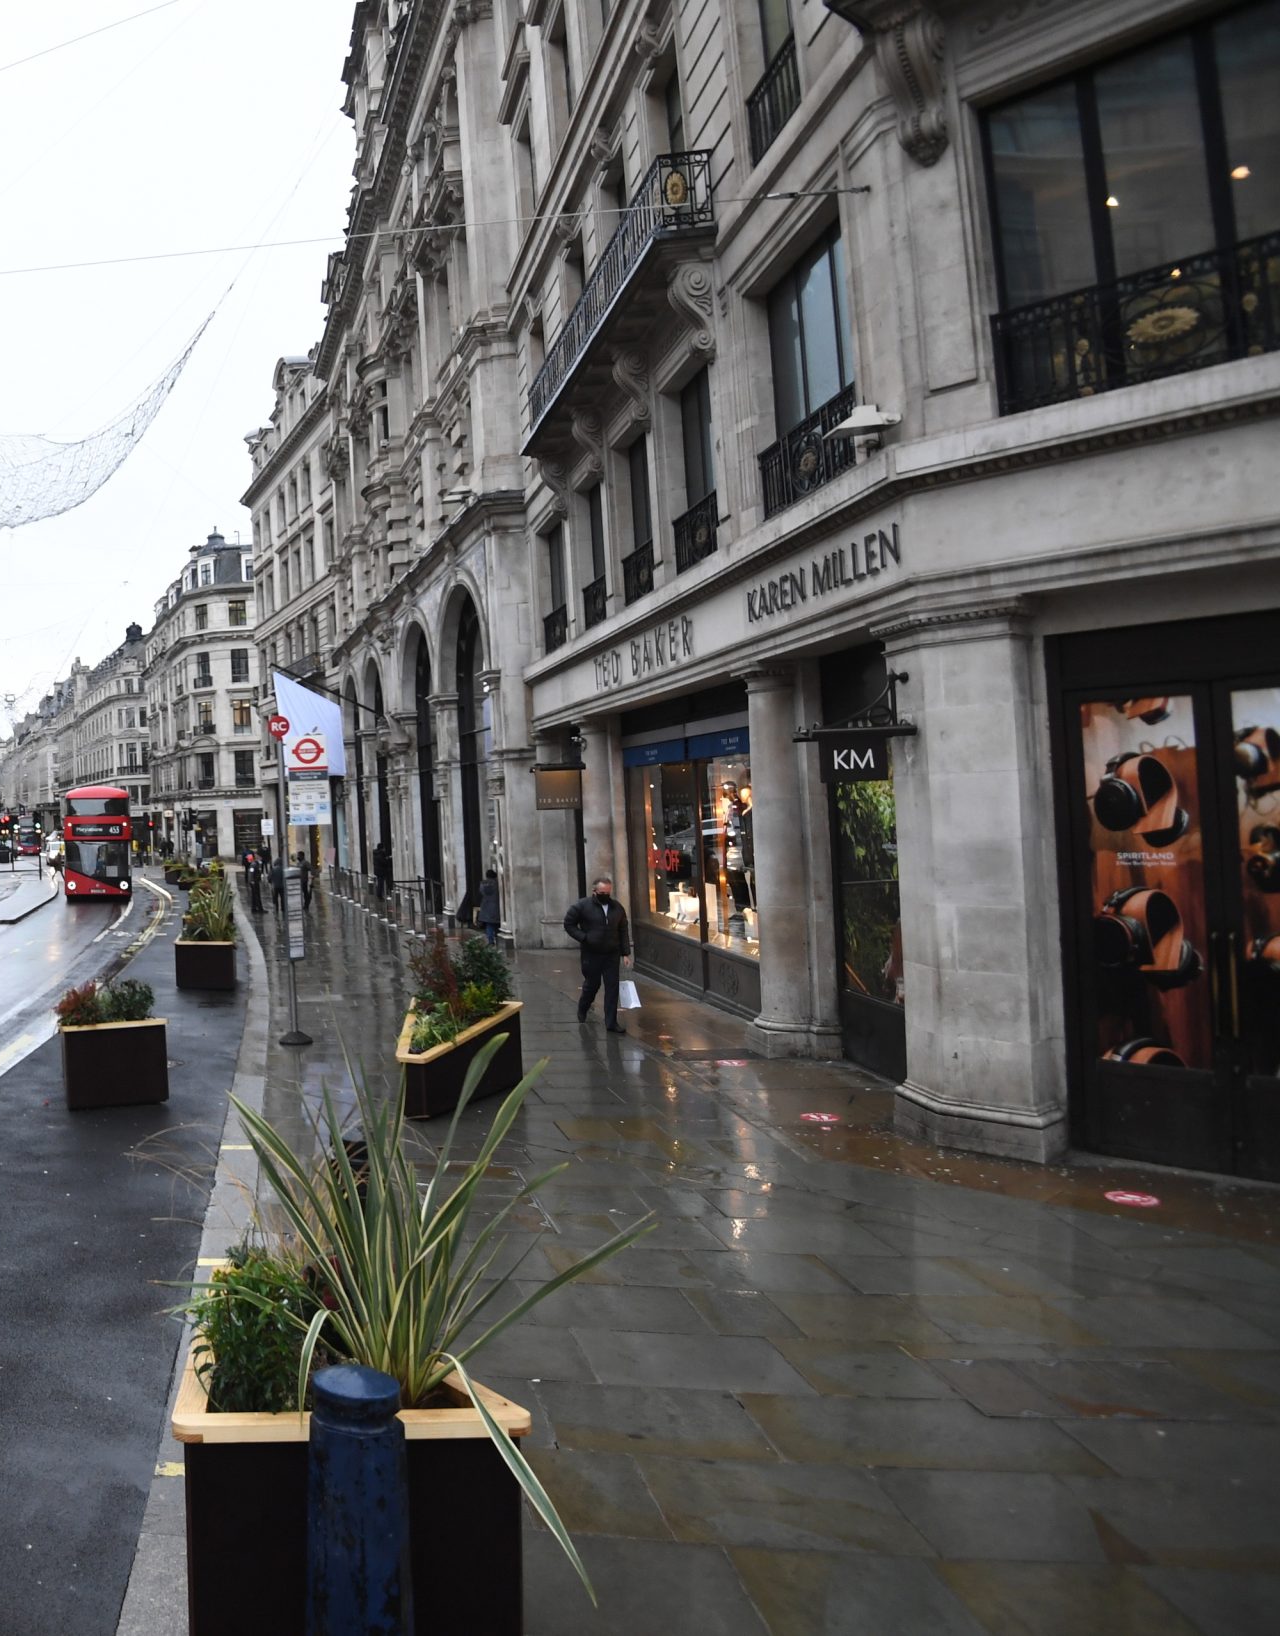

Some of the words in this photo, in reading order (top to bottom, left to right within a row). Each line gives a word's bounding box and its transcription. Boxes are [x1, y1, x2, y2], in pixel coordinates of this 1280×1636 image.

[747, 566, 807, 623] KAREN
[812, 522, 900, 597] MILLEN
[593, 649, 621, 691] TED
[630, 615, 693, 676] BAKER
[271, 721, 287, 731] RC
[833, 748, 875, 770] KM
[1116, 852, 1175, 860] SPIRITLAND
